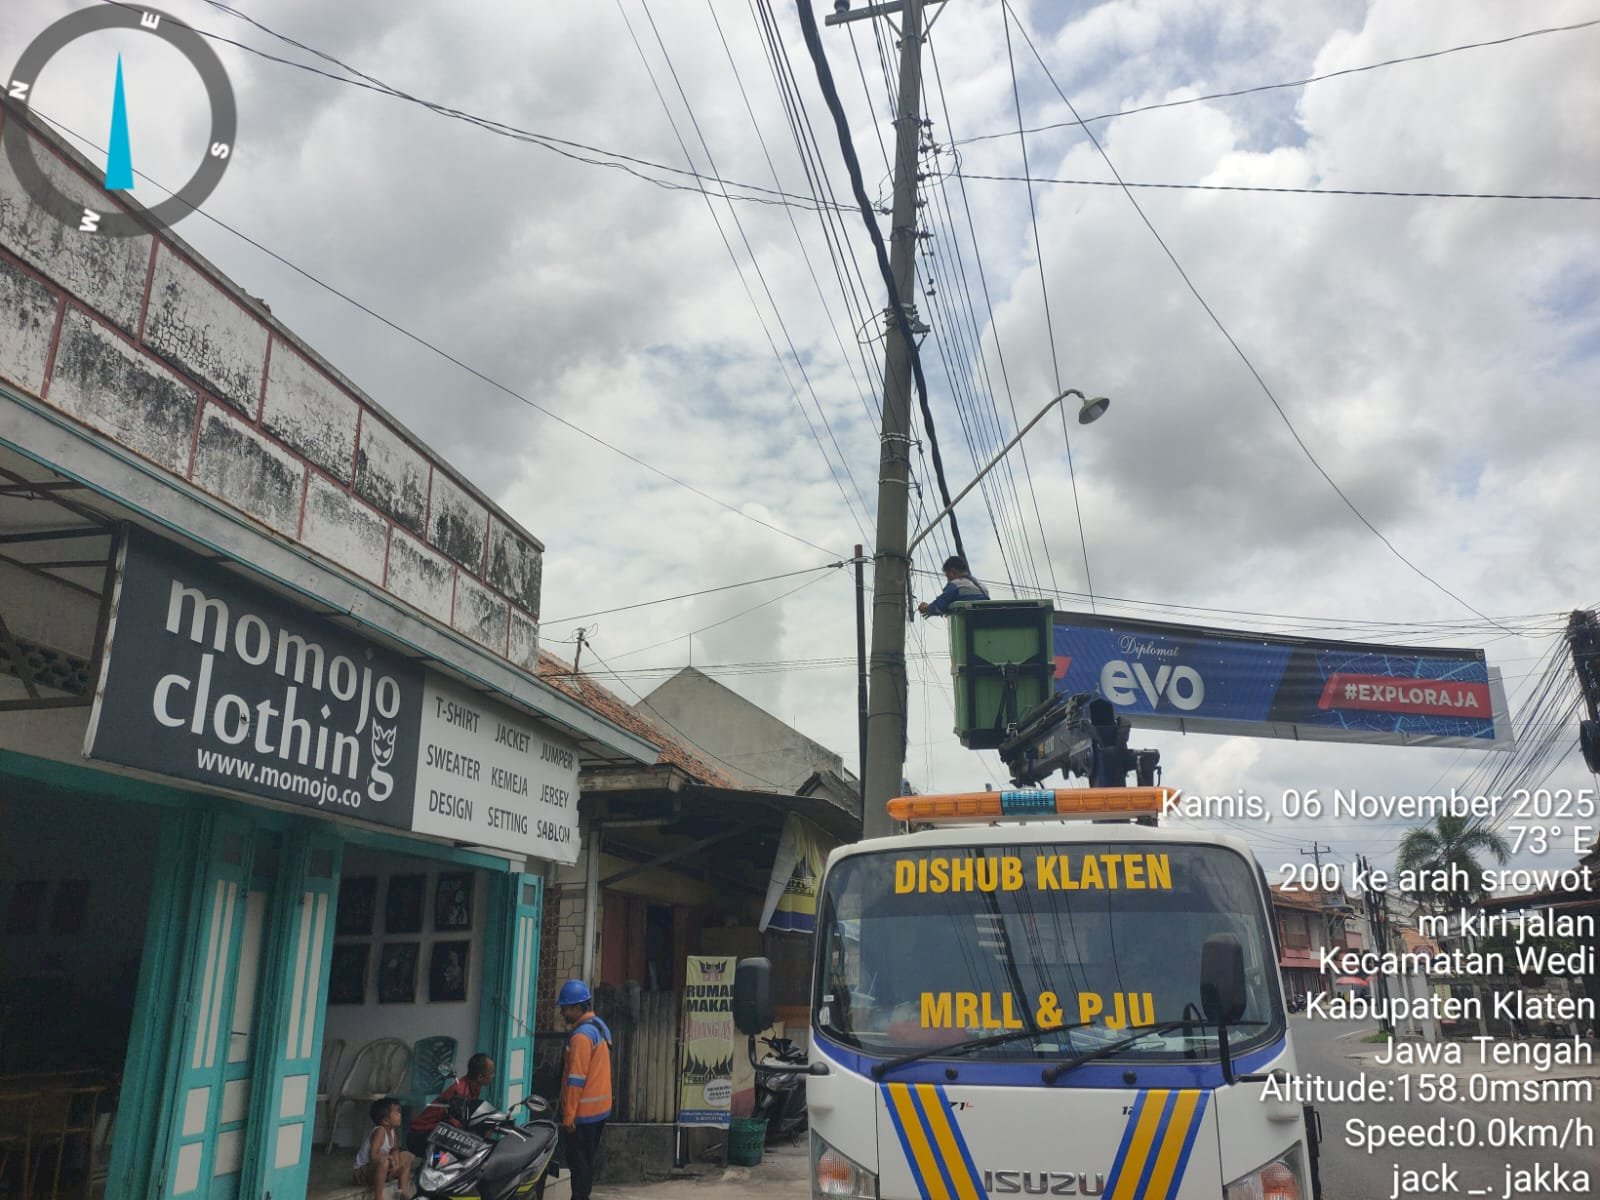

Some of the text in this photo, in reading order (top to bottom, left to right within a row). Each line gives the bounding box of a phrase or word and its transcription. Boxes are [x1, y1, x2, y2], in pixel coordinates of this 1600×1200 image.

[166, 579, 401, 735] momojo
[1118, 632, 1180, 660] Diplomat
[153, 653, 395, 802] clothing
[435, 696, 574, 771] T-SHIRT JACKET JUMPER
[197, 748, 361, 809] www.momojo.co
[426, 744, 570, 809] SWEATER KEMEJA JERSEY
[429, 789, 473, 822] DESIGN
[487, 806, 528, 835] SETTING
[895, 854, 1172, 894] DISHUB KLATEN
[920, 992, 1155, 1030] MRLL & PJU
[984, 1168, 1105, 1196] ISUZU
